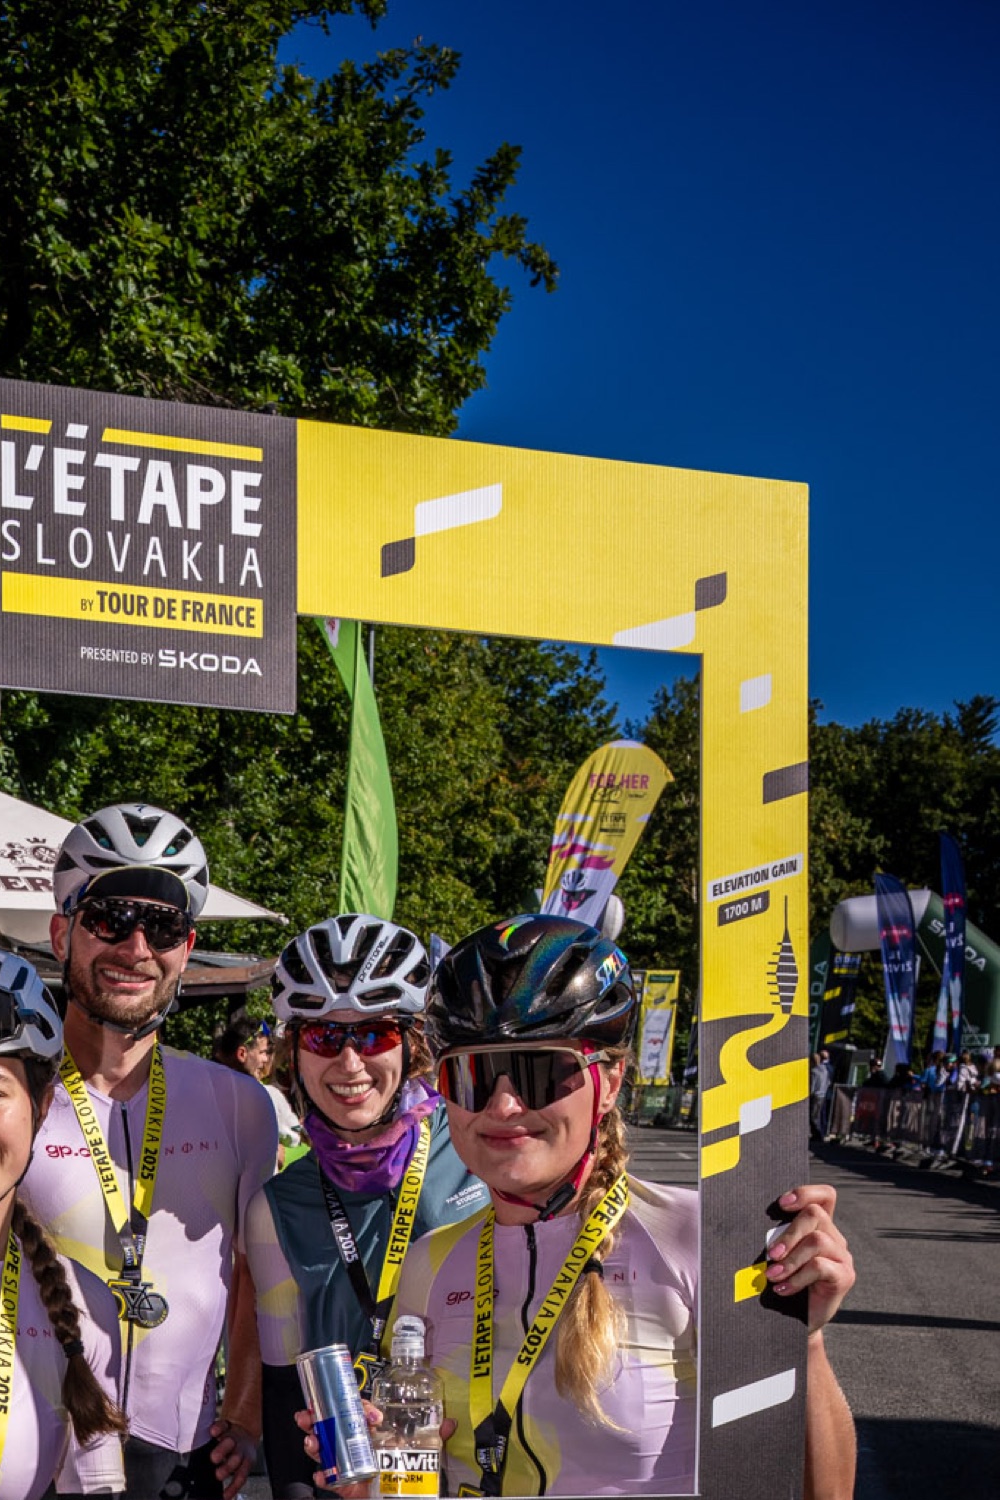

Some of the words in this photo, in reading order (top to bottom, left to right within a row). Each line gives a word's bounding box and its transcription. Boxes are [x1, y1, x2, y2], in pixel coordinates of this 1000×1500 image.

[1, 519, 263, 588] SLOVAKIA
[81, 598, 94, 611] BY
[96, 590, 149, 617] TOUR
[153, 596, 177, 620] DE
[182, 599, 256, 629] FRANCE
[80, 646, 139, 664] PRESENTED
[141, 653, 154, 666] BY
[620, 773, 650, 789] HER
[712, 871, 769, 897] ELEVATION
[771, 859, 798, 882] GAIN
[724, 903, 749, 921] 1700
[750, 897, 763, 912] M
[59, 1060, 100, 1136] SLOVAKIA
[146, 1069, 166, 1142] SLOVAKIA
[90, 1137, 118, 1194] L'ETAPE
[140, 1147, 158, 1181] 2025
[338, 1231, 359, 1263] 2025
[387, 1207, 413, 1265] L'ETAPE
[538, 1224, 604, 1318] SLOVAKIA
[473, 1311, 491, 1378] L'ETAPE
[518, 1323, 548, 1366] 2025
